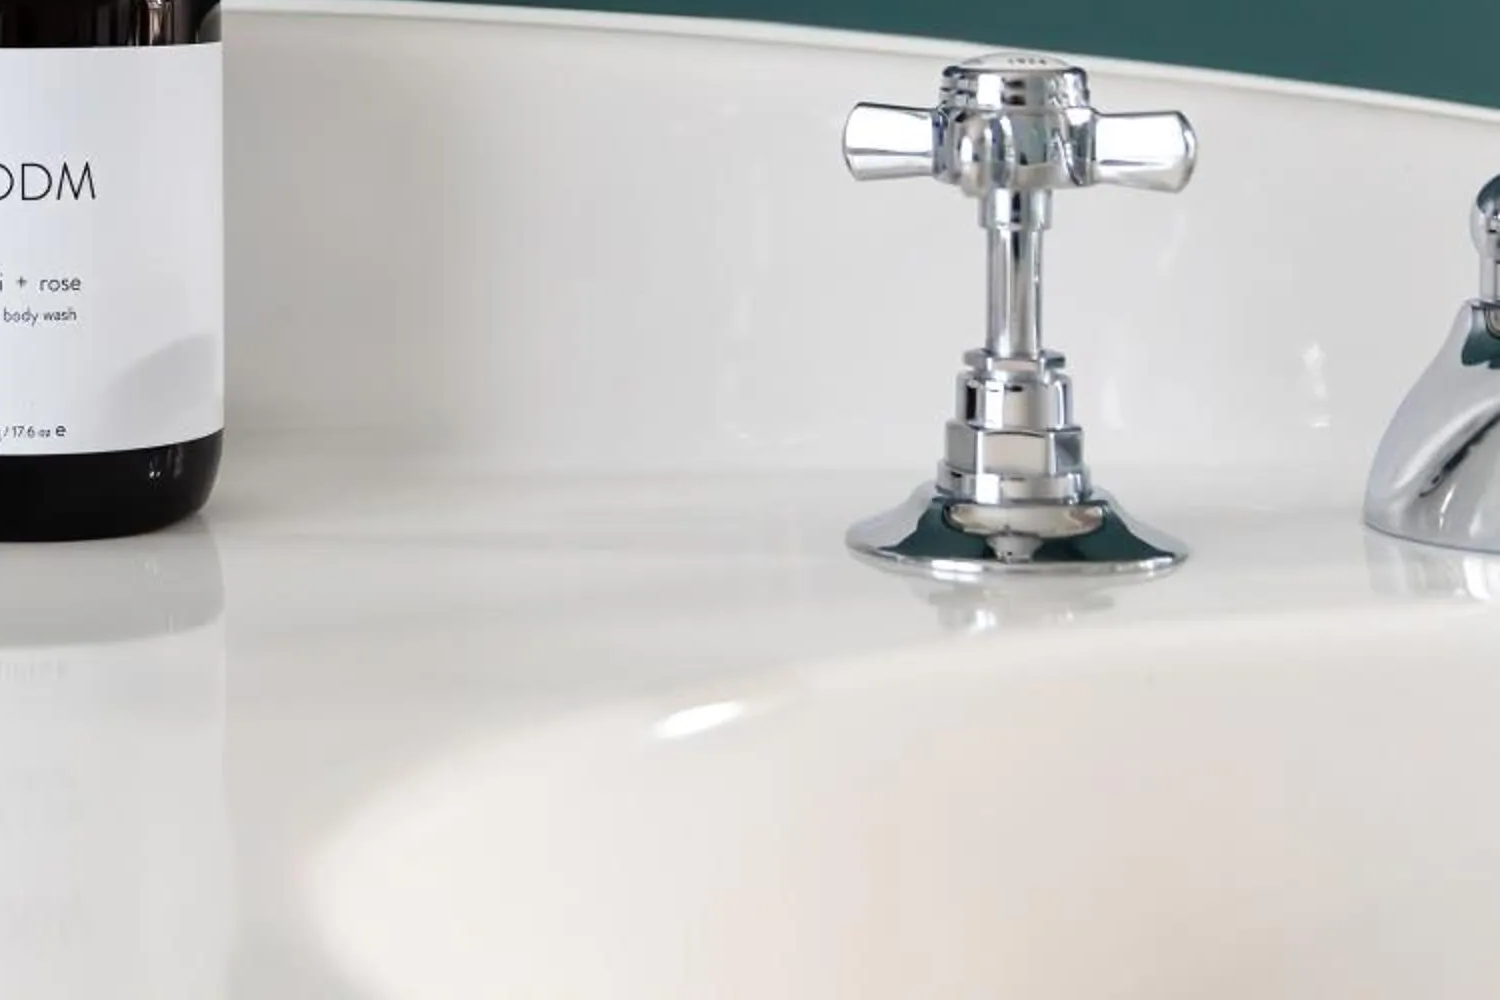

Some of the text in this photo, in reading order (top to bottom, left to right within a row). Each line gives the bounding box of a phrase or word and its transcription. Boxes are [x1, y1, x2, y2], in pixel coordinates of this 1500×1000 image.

[38, 277, 82, 292] rose
[3, 306, 39, 326] body
[43, 307, 77, 322] wash
